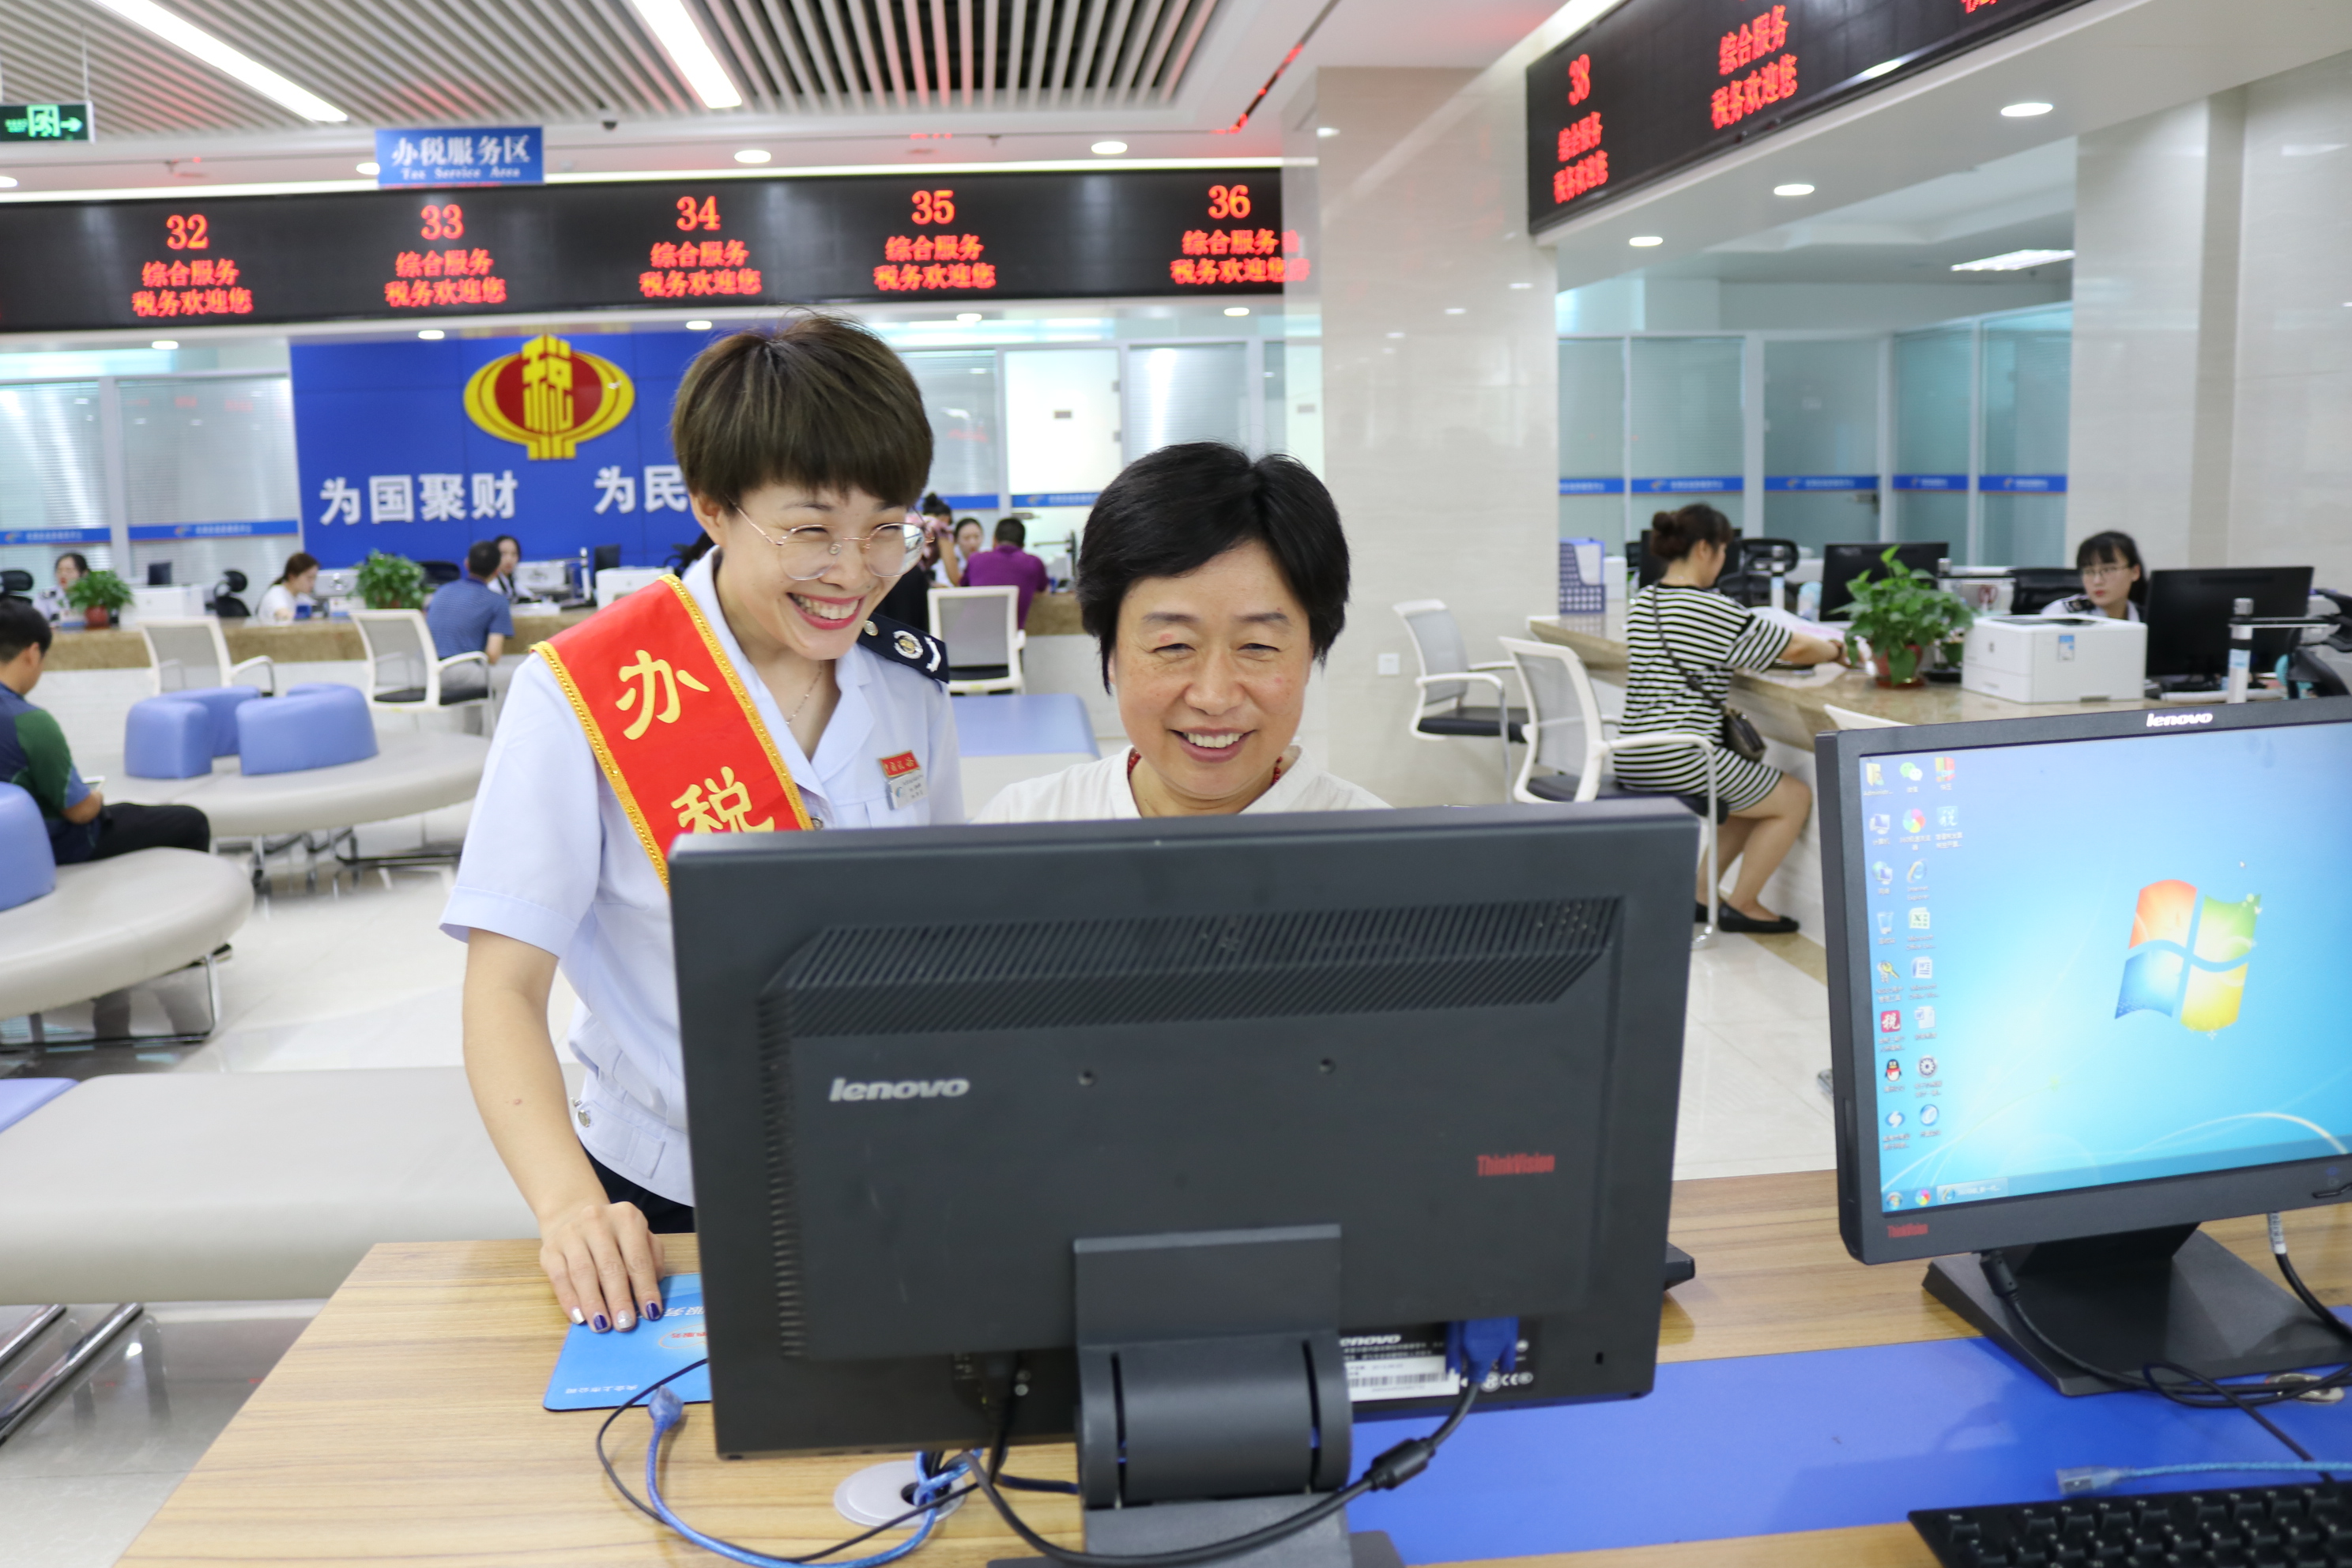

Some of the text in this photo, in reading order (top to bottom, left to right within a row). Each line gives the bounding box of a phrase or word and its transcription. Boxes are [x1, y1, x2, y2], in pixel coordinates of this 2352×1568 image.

[1718, 5, 1790, 75] 综合服务
[1711, 53, 1798, 130] 税务欢迎您
[392, 134, 530, 166] 办税服务区
[435, 166, 481, 179] Service
[489, 165, 521, 179] Area
[677, 195, 721, 231] 34
[911, 190, 955, 224] 35
[1208, 184, 1251, 219] 36
[167, 214, 209, 250] 32
[420, 204, 465, 240] 33
[650, 239, 750, 269] 综合服务
[884, 233, 984, 262] 综合服务
[1182, 228, 1280, 255] 综合服务
[141, 258, 240, 288] 综合服务
[395, 247, 494, 278] 综合服务
[873, 262, 997, 291] 税务欢迎您
[384, 276, 507, 307] 税务欢迎您
[639, 268, 763, 298] 税务欢迎您
[131, 287, 254, 318] 税务欢迎您
[320, 465, 689, 526] 为国聚财 为民
[2146, 713, 2213, 727] lenovo
[828, 1076, 971, 1102] lenovo
[1339, 1334, 1402, 1347] enovo
